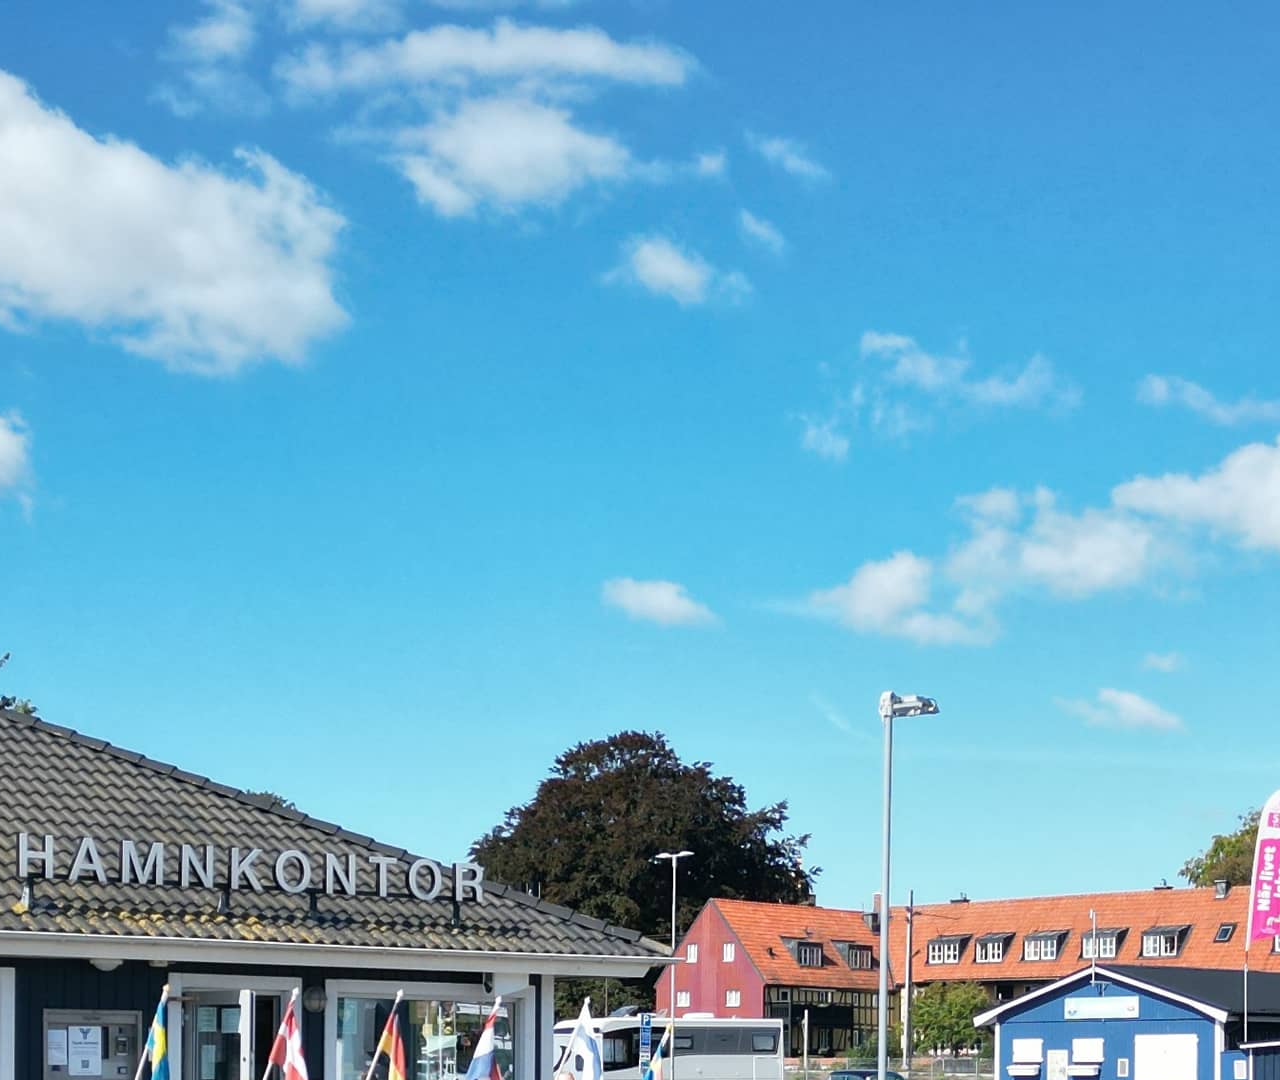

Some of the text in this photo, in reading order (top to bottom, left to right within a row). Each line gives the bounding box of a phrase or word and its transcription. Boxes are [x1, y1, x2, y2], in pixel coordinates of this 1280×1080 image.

[18, 832, 485, 901] HAMNKONTOR
[1257, 846, 1276, 911] När livet
